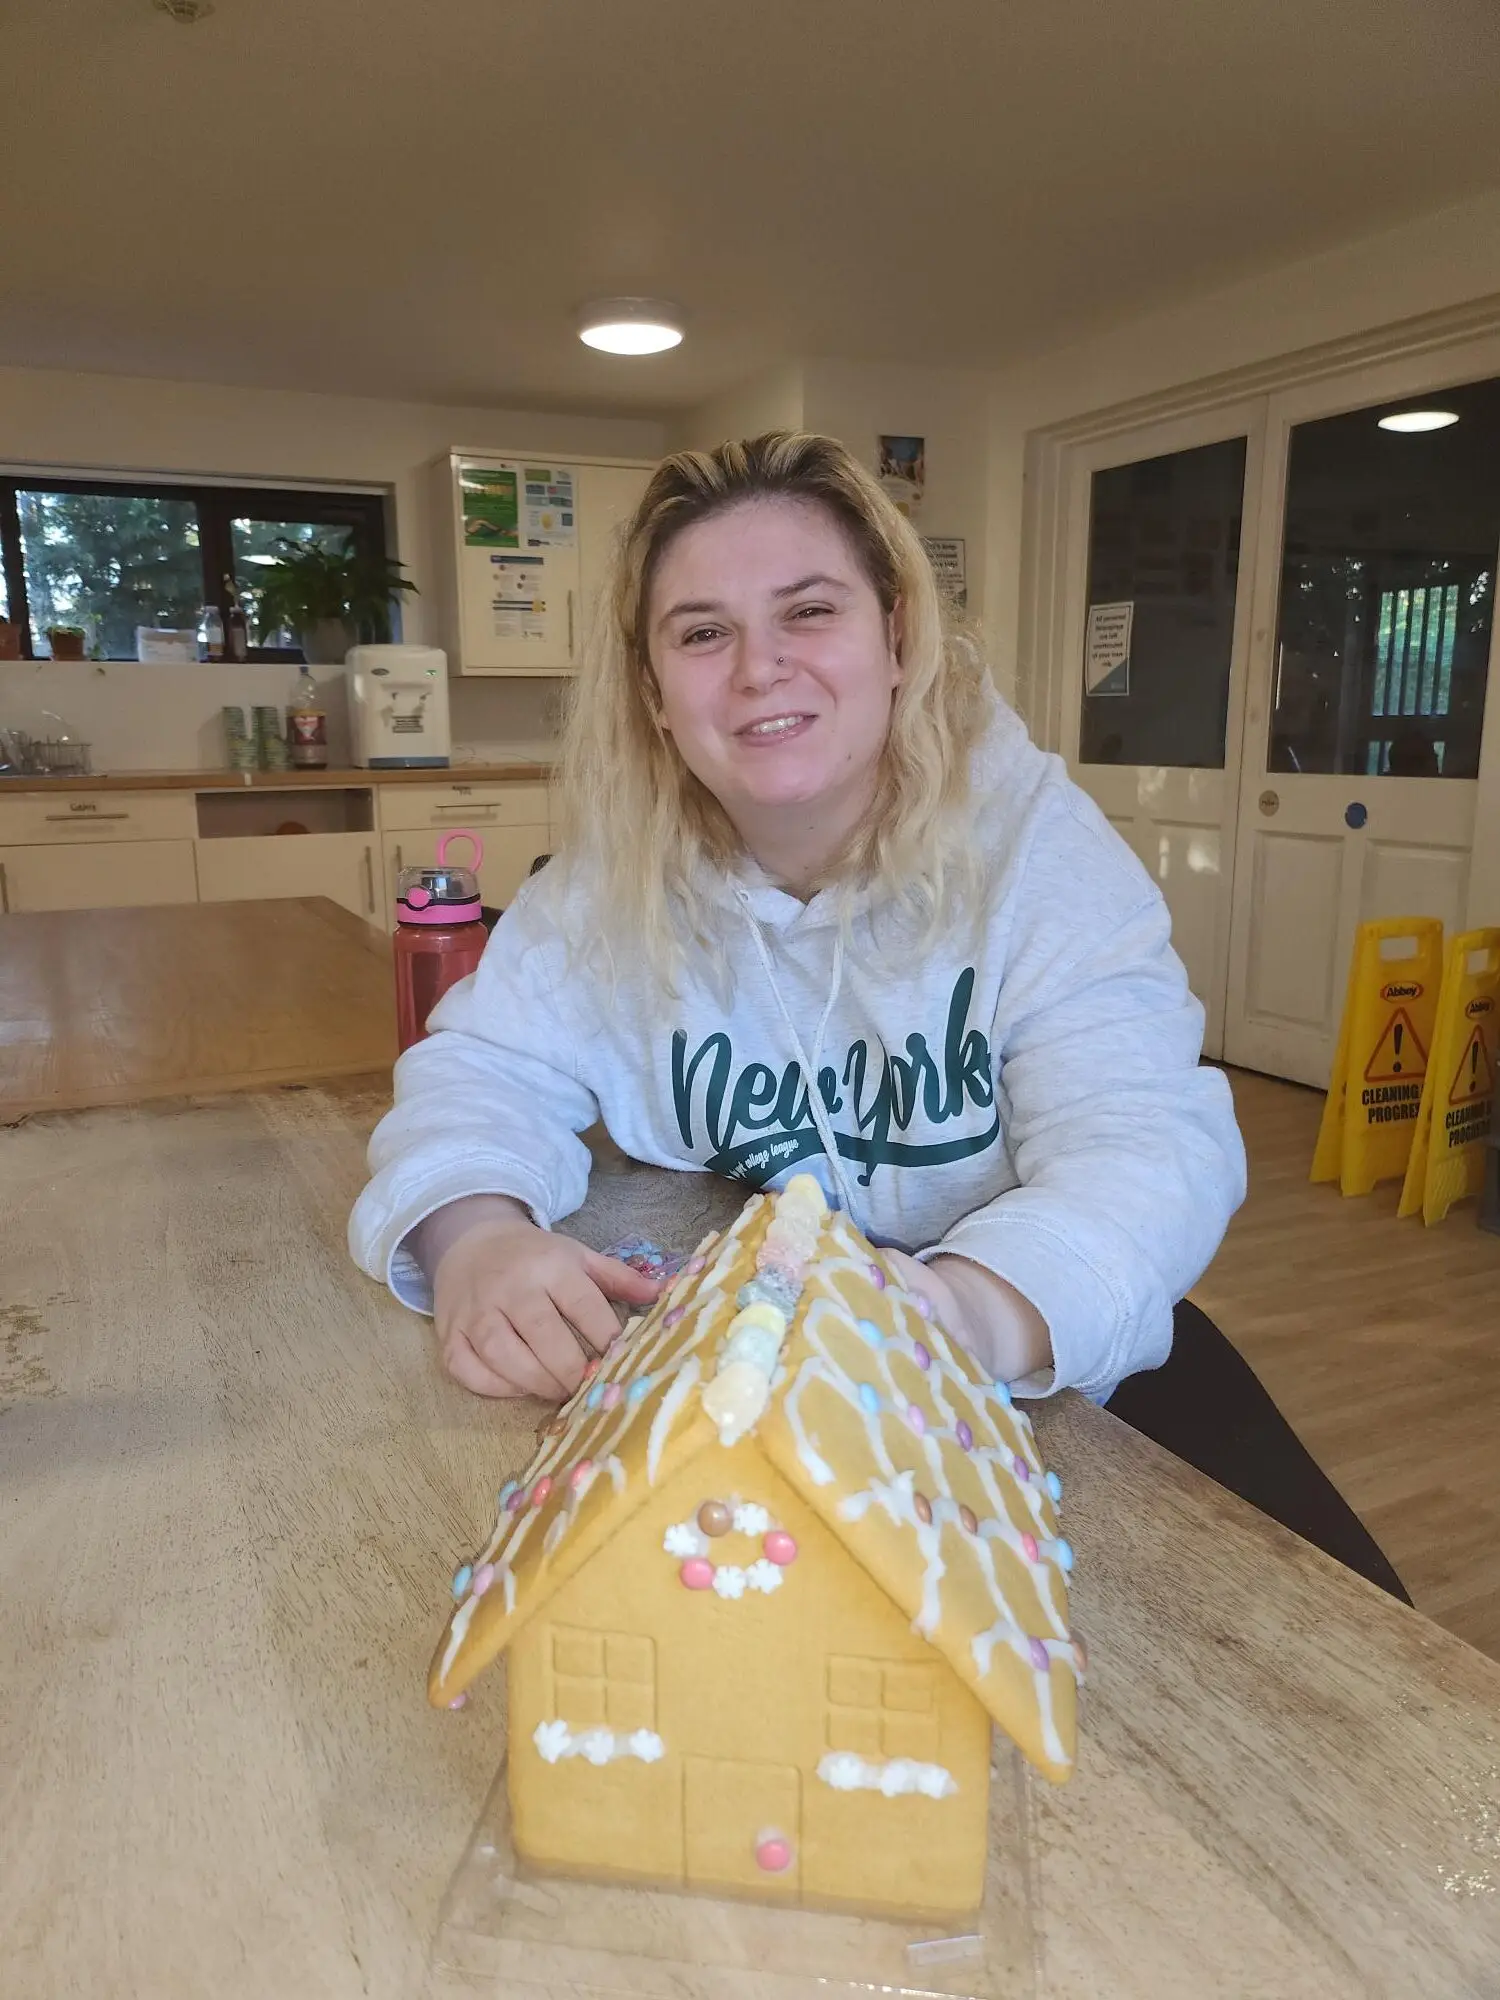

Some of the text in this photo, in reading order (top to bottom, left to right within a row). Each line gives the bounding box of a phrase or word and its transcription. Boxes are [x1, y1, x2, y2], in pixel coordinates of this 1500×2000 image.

[1387, 986, 1417, 998] Abbey
[672, 967, 994, 1186] New York
[1362, 1084, 1420, 1106] CLEANING
[1368, 1102, 1420, 1124] PROGRE
[745, 1139, 799, 1169] college league
